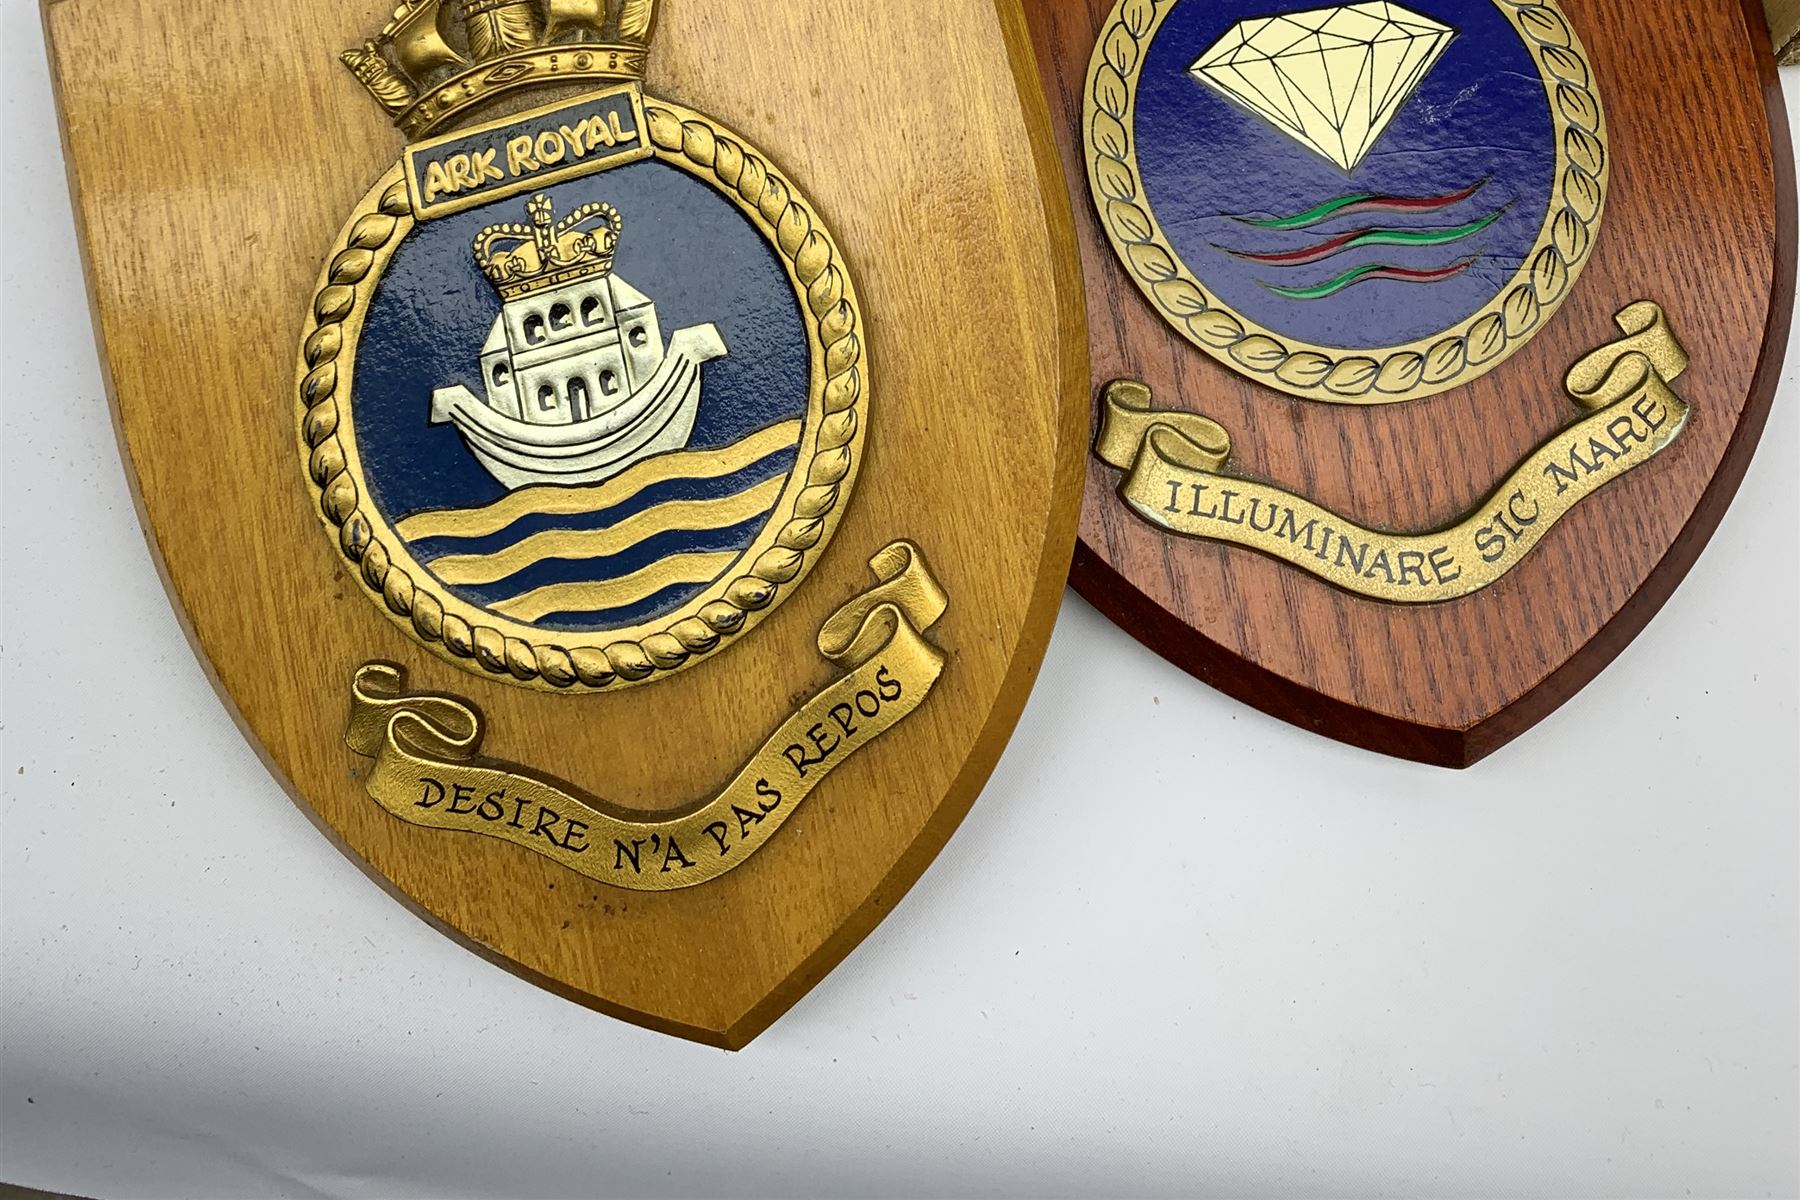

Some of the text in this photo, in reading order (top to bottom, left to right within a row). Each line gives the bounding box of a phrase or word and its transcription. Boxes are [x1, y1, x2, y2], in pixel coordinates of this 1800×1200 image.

[424, 111, 637, 202] ARK ROYAL
[1164, 392, 1668, 586] ILLUMINARE SIC MARE
[414, 665, 903, 874] DESIRE N'A PAS REPOS
